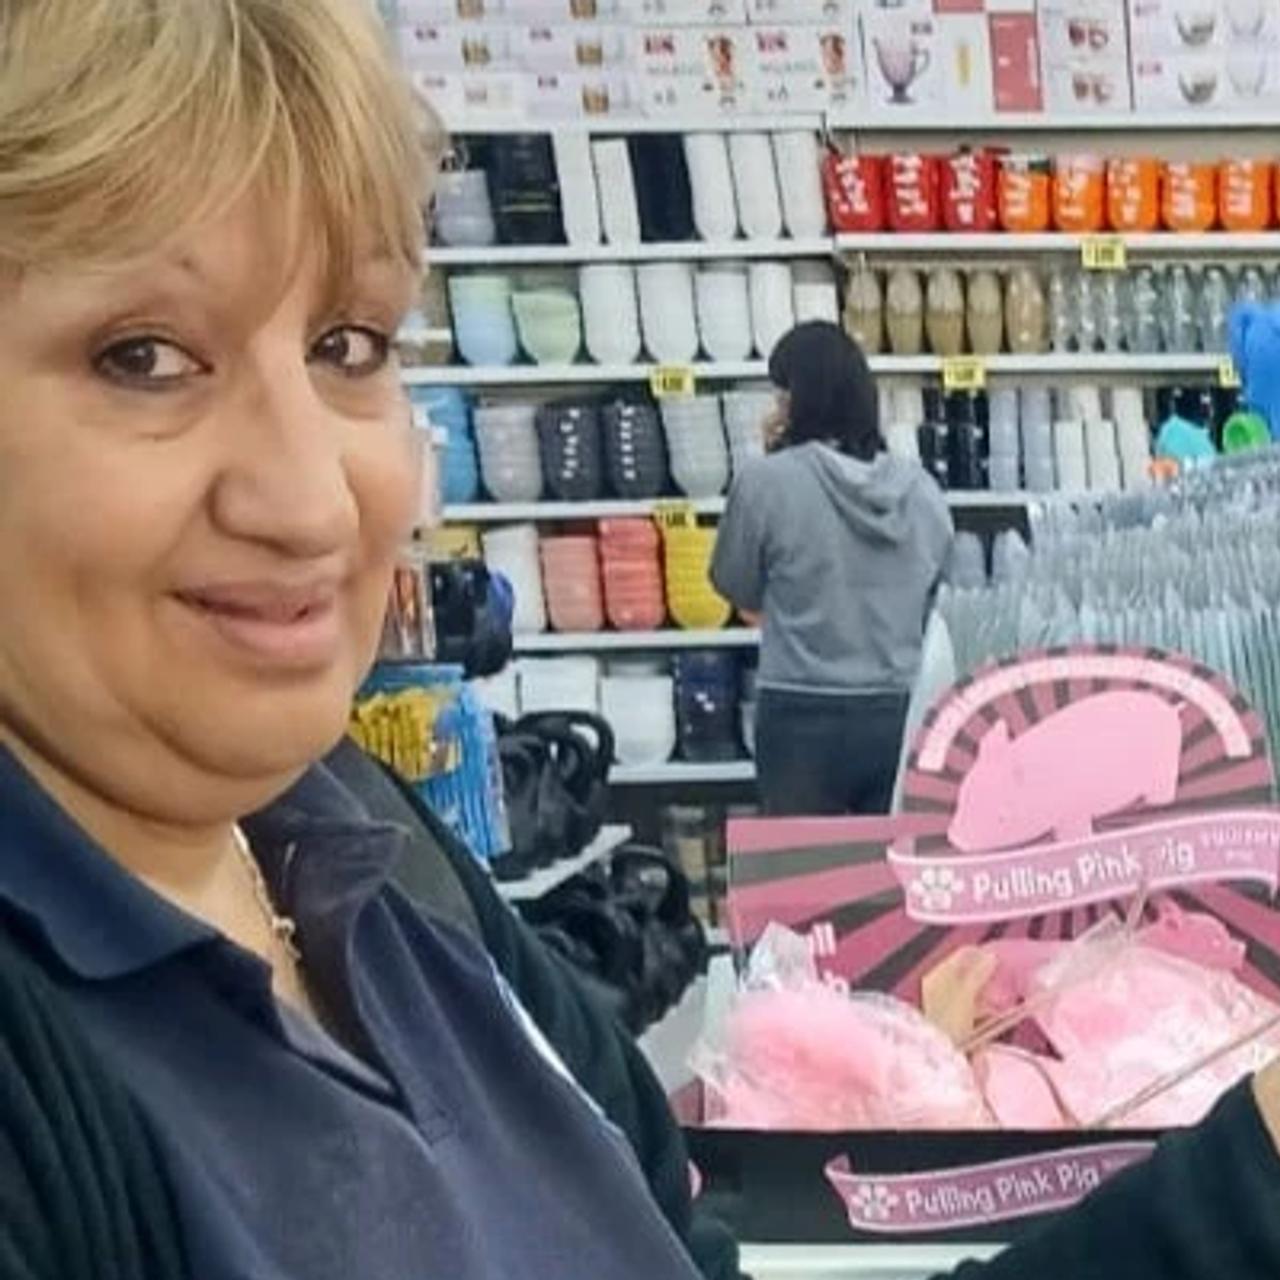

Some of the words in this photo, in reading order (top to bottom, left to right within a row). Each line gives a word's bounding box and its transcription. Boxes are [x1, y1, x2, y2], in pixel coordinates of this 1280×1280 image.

[973, 867, 1073, 901] Pulling
[1077, 845, 1143, 884] Pink
[907, 1183, 995, 1216] Pulling
[998, 1170, 1053, 1201] Pink
